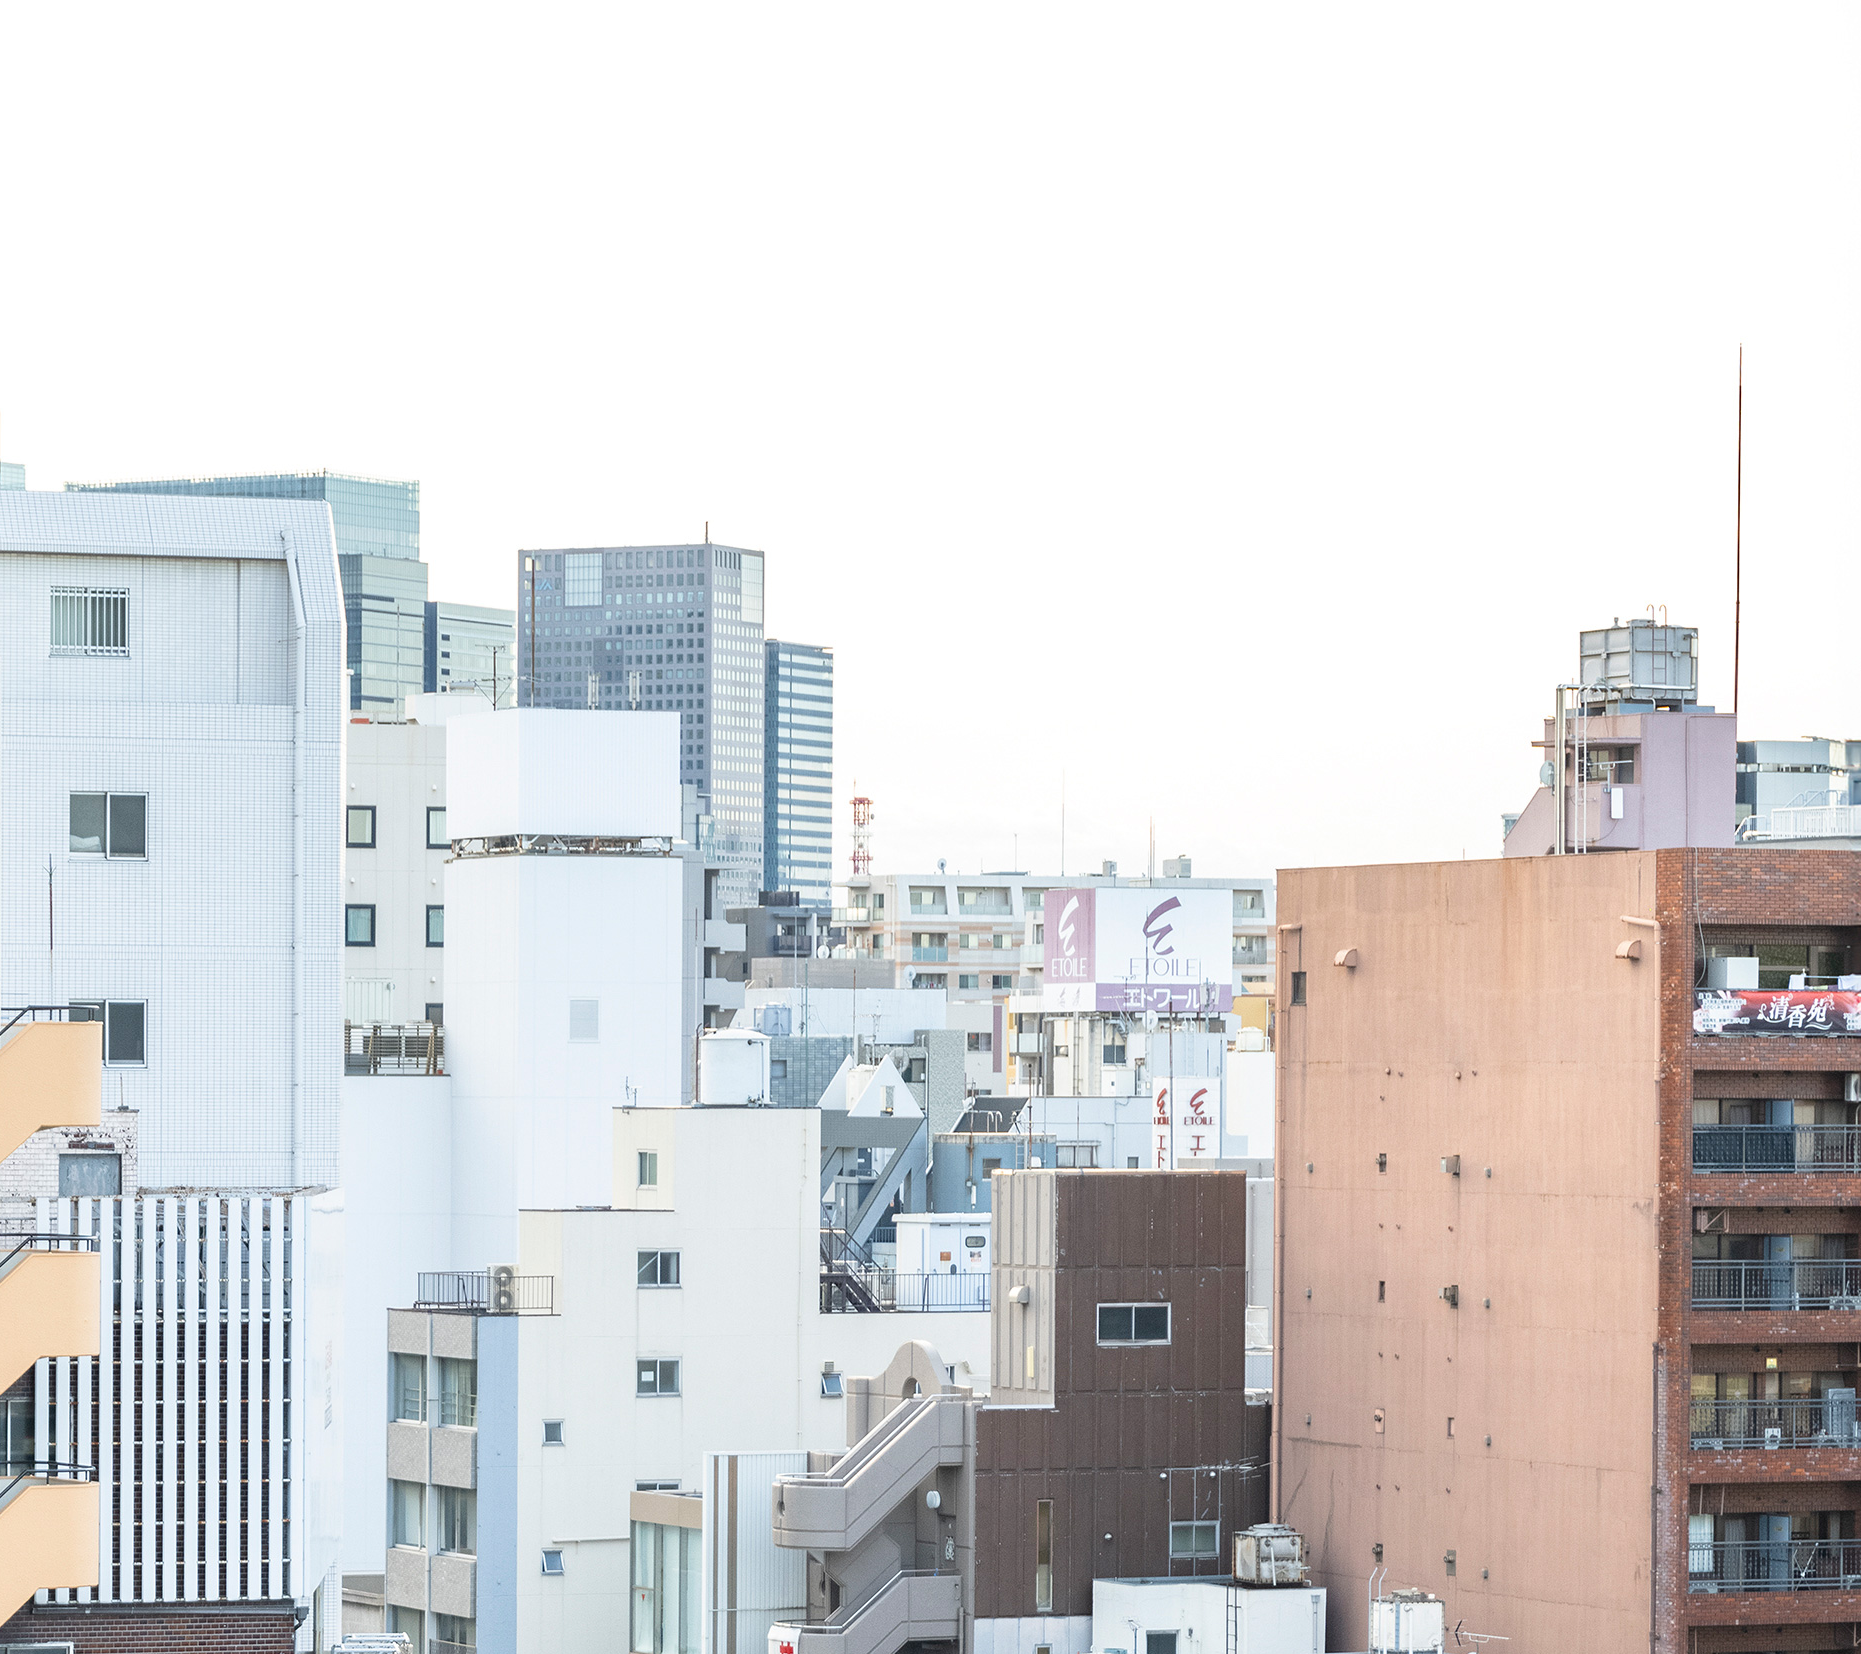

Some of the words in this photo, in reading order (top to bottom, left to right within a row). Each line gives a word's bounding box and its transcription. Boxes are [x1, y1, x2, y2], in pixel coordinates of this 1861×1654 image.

[1052, 957, 1087, 977] ETOILE
[1129, 957, 1198, 977] ETOILE
[1769, 995, 1832, 1028] 清香苑
